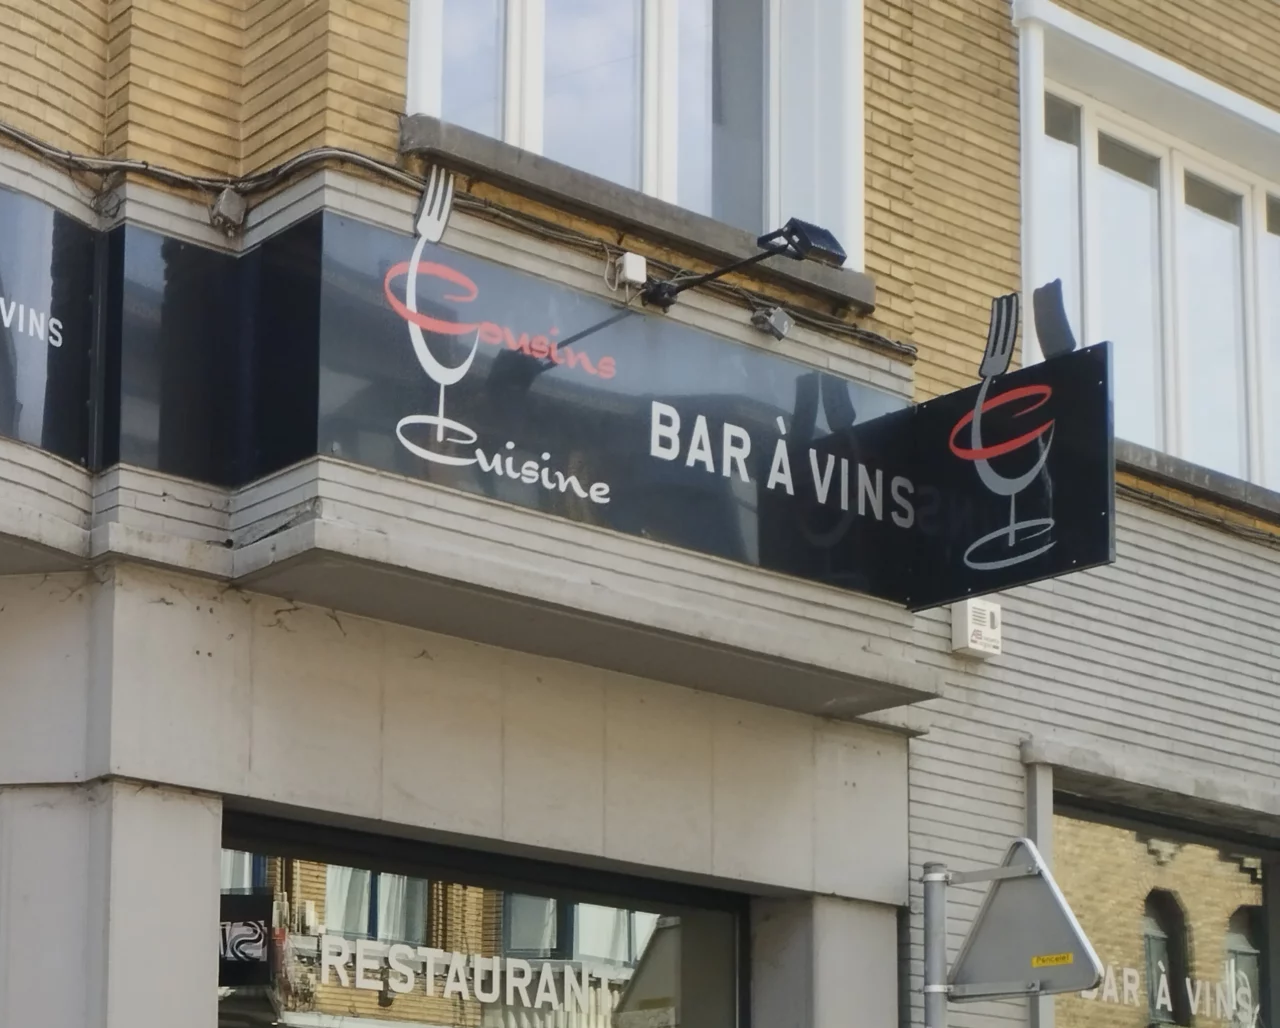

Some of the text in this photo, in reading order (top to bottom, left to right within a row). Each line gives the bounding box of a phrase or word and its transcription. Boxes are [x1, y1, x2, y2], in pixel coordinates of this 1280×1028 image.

[384, 260, 617, 380] Cousins
[395, 414, 611, 504] Cuisine
[649, 400, 752, 483] BAR
[766, 415, 796, 497] À
[808, 447, 915, 529] VINS
[320, 933, 616, 1016] RESTAURANT
[1155, 959, 1173, 1013] À
[1185, 976, 1254, 1024] VINS
